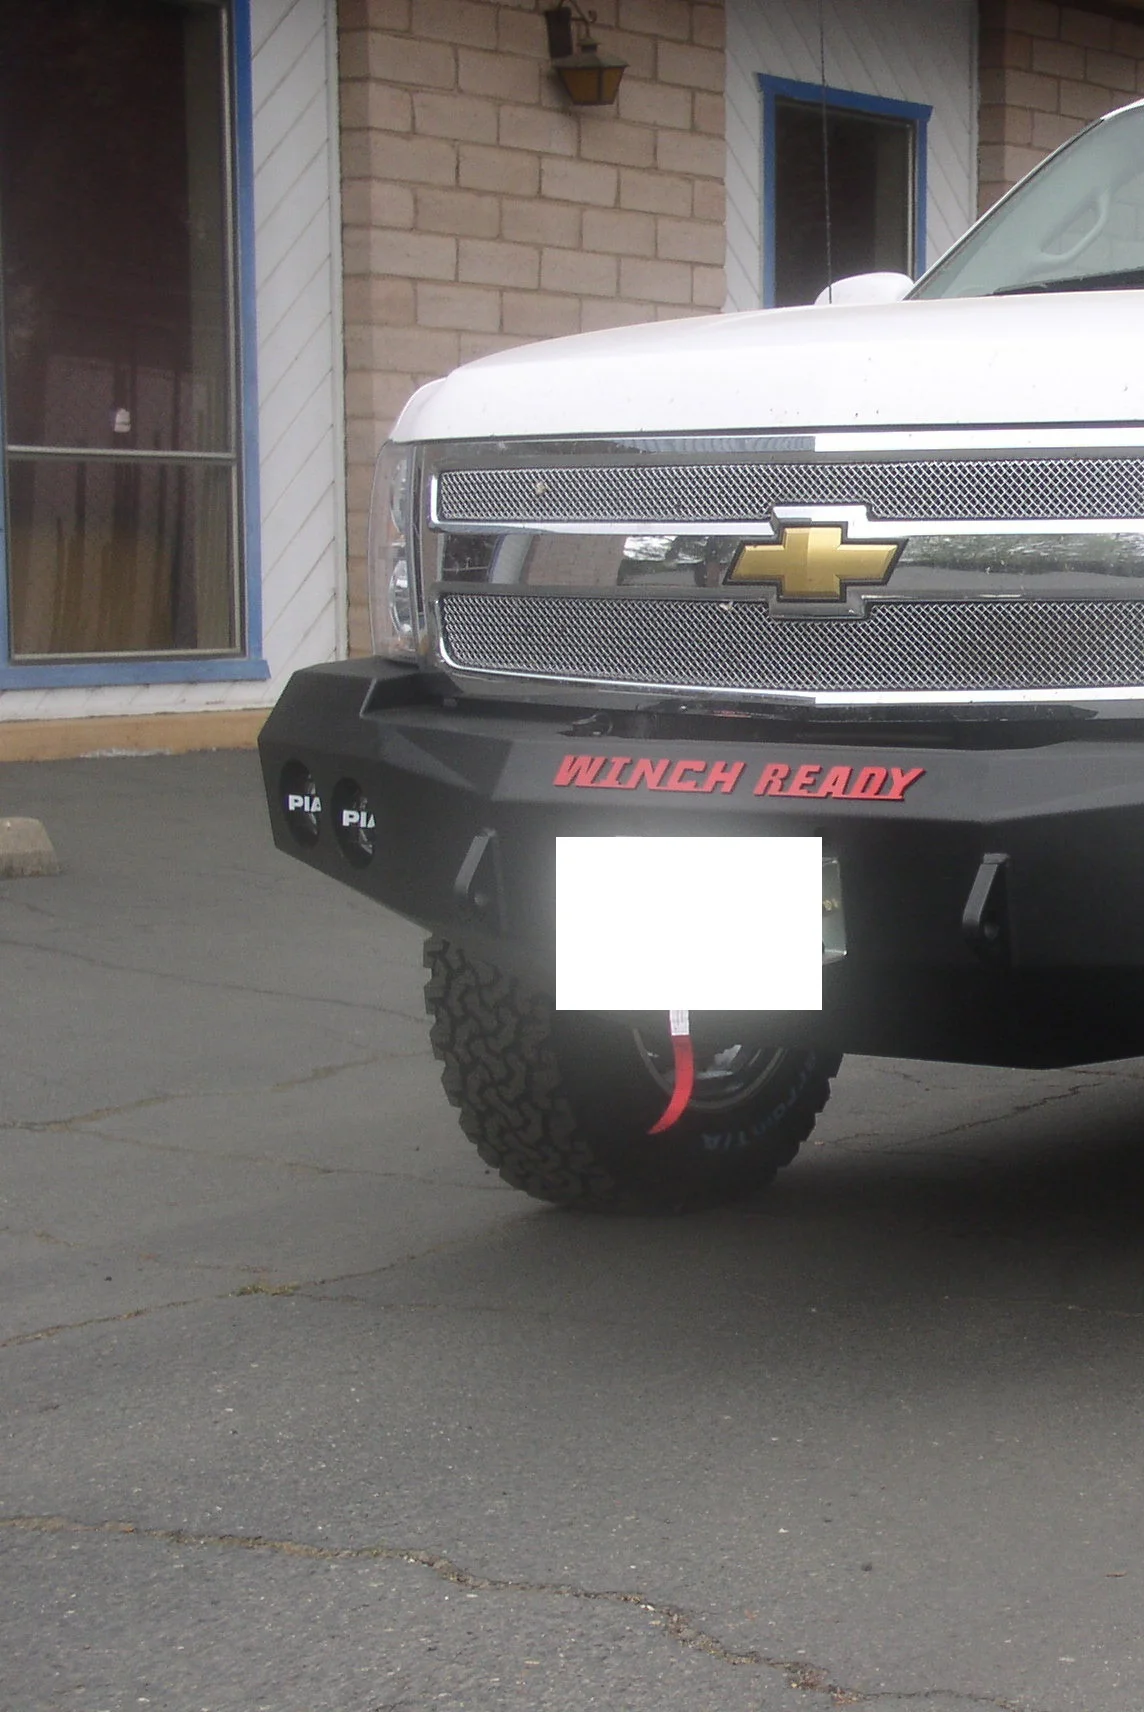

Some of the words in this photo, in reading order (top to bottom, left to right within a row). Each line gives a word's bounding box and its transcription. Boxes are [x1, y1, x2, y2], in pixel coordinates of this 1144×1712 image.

[553, 754, 746, 794] WINCH
[753, 762, 926, 801] READY
[288, 794, 322, 812] PIA
